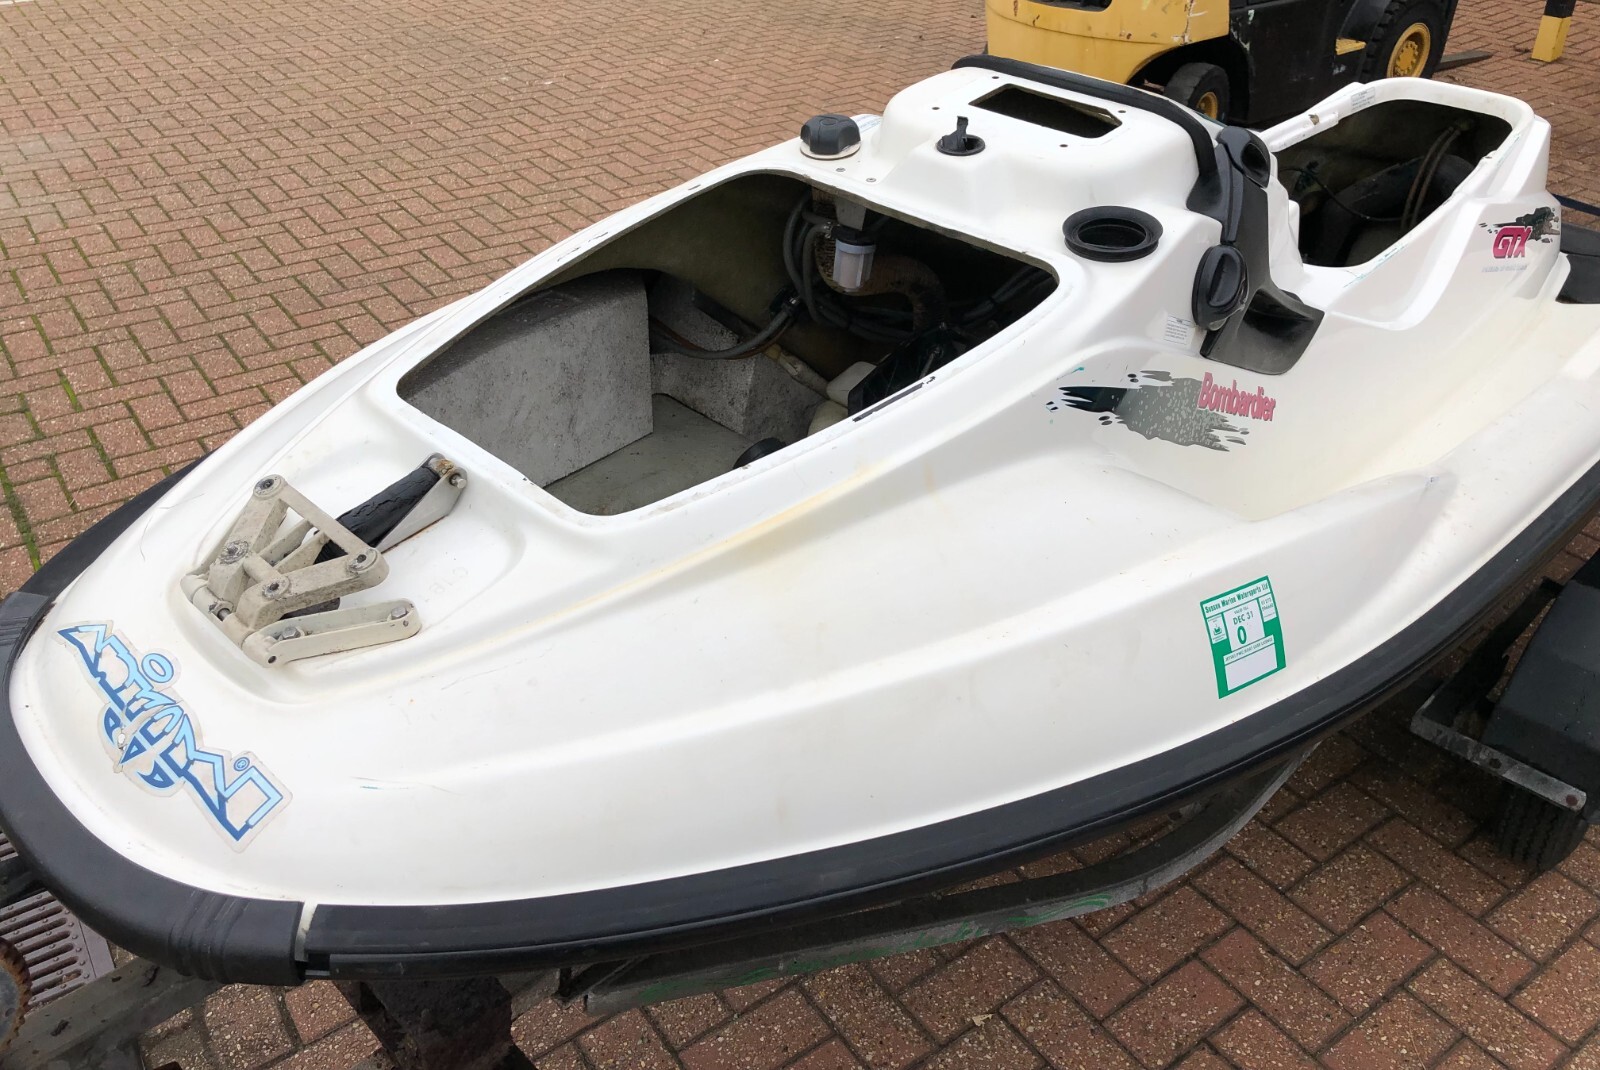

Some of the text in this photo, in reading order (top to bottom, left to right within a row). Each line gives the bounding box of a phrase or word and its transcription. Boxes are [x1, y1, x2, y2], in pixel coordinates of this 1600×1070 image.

[1493, 227, 1532, 258] GTX
[1198, 372, 1276, 421] Bombardier
[1221, 597, 1236, 607] Marine
[1236, 586, 1261, 601] Watersports
[1233, 614, 1245, 625] DEC
[1247, 611, 1254, 620] 31
[1237, 626, 1247, 644] 0
